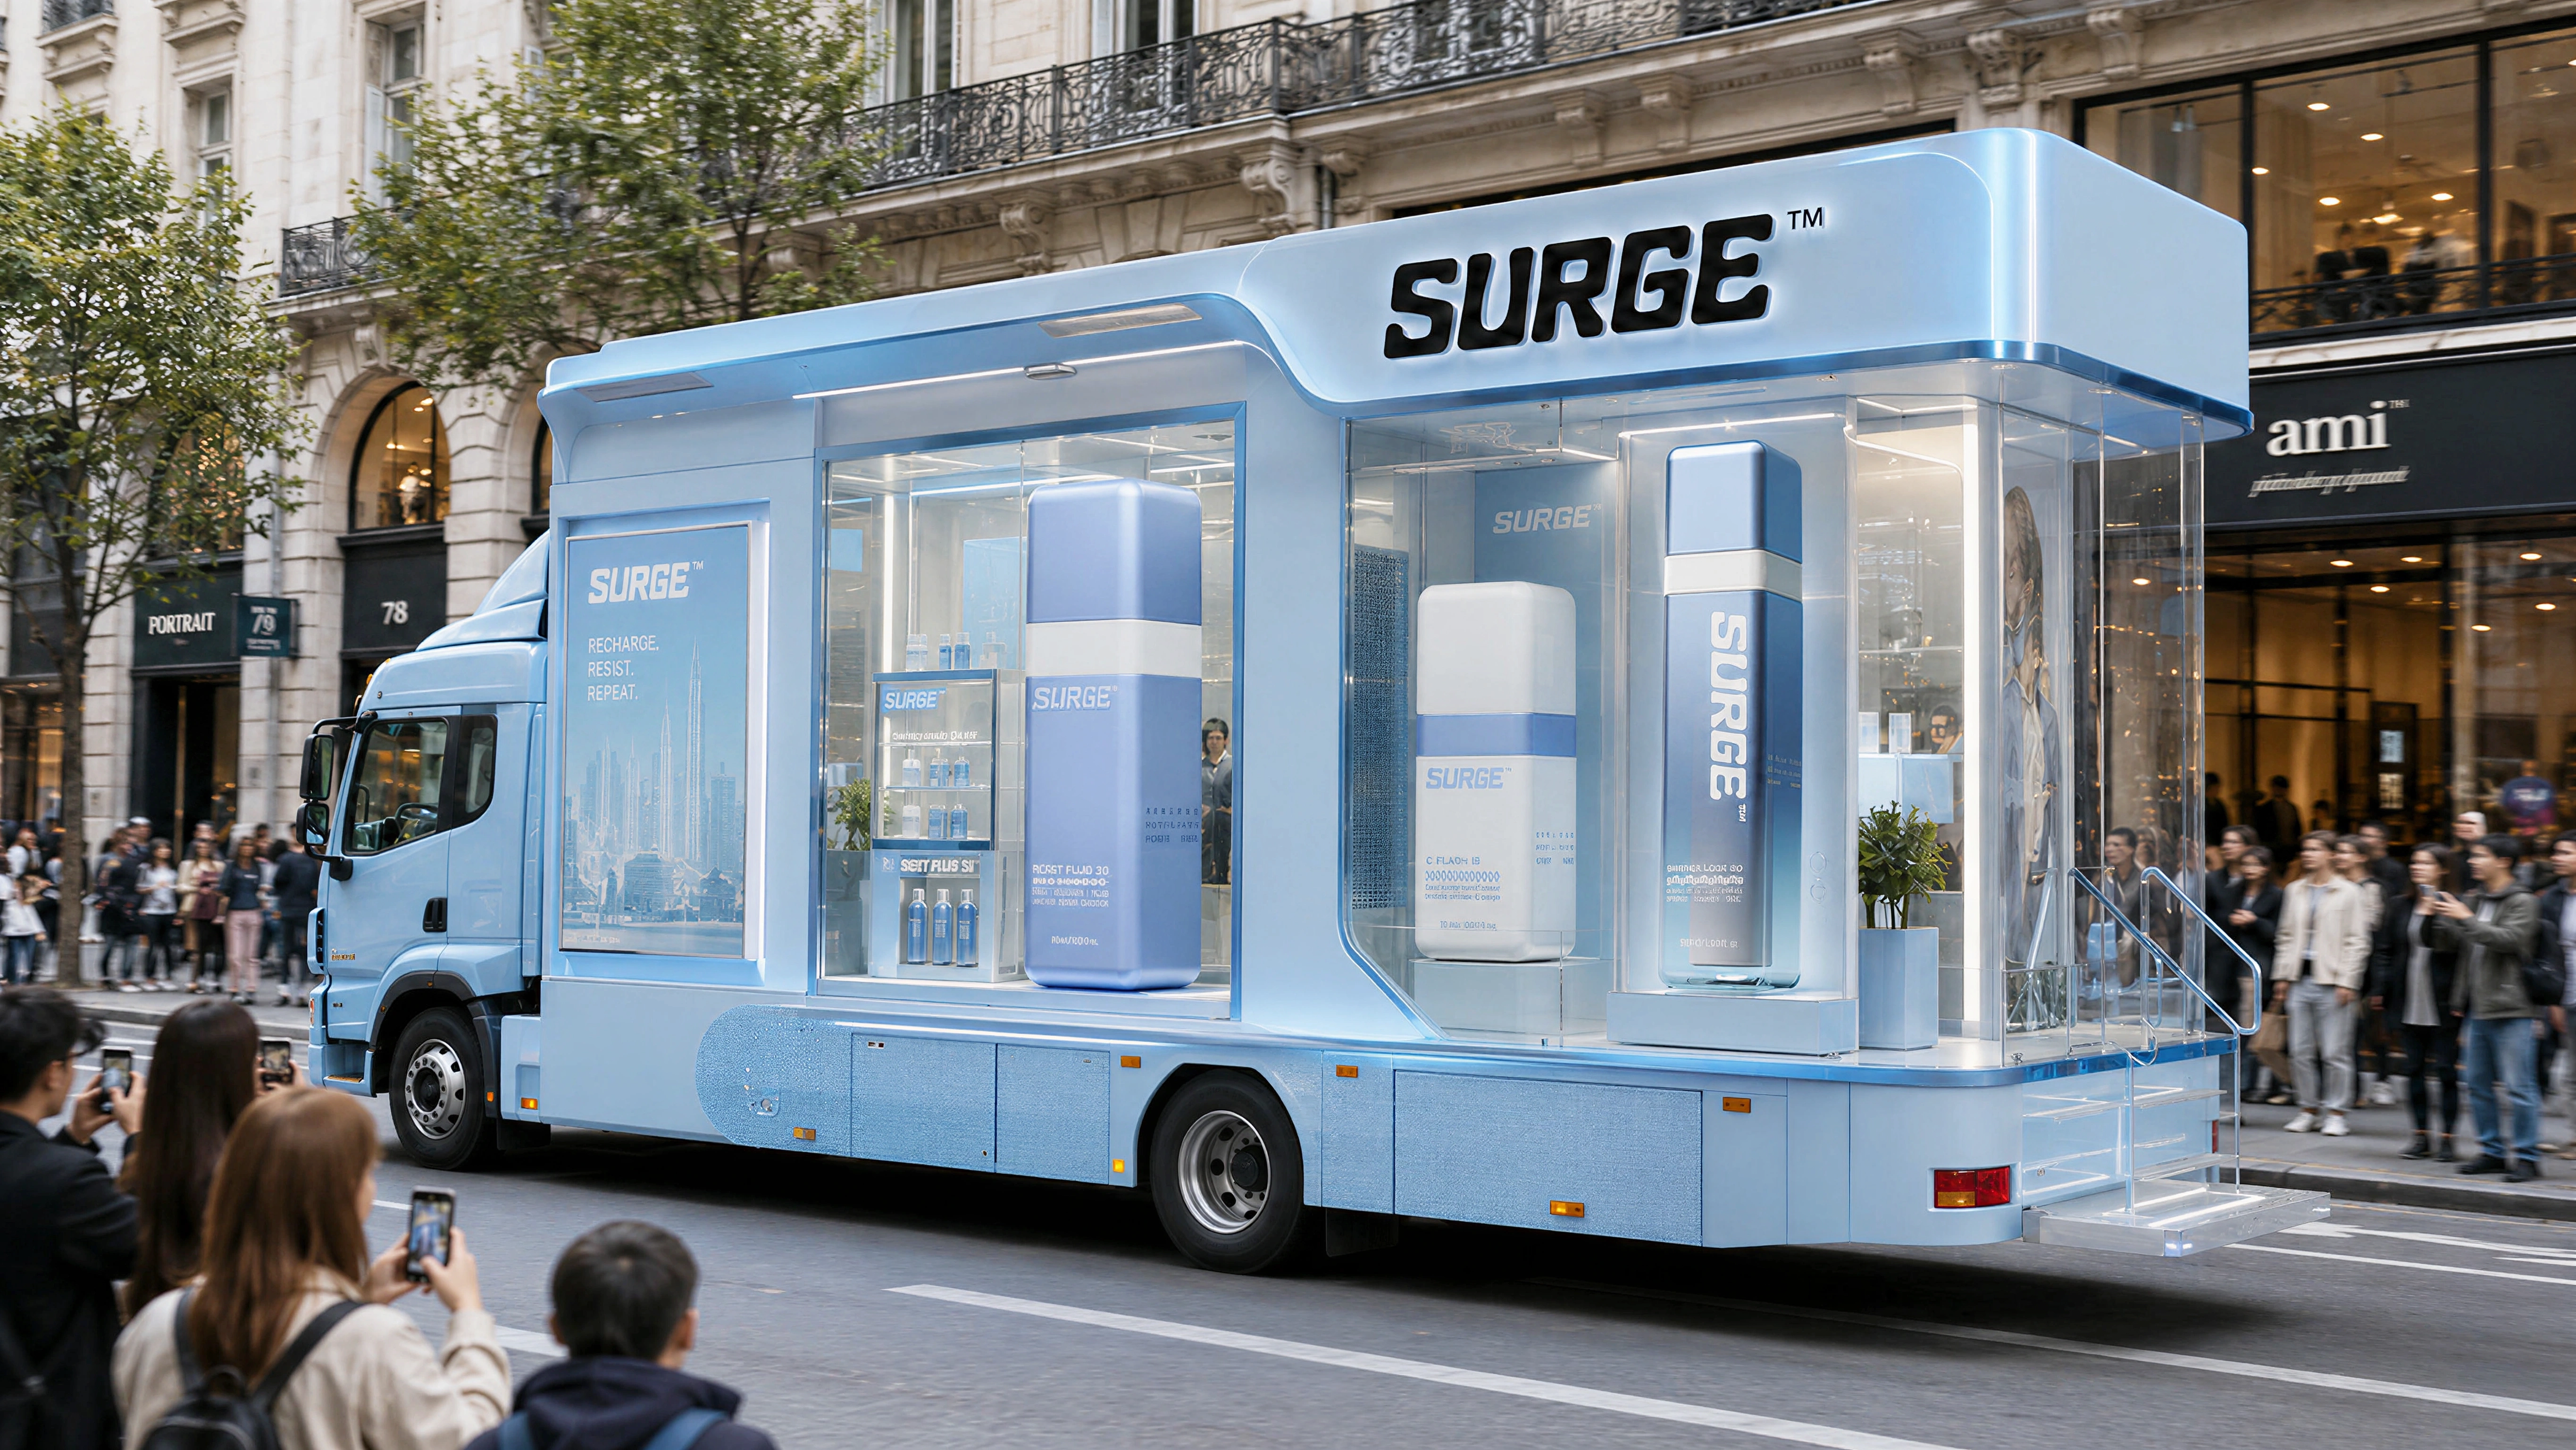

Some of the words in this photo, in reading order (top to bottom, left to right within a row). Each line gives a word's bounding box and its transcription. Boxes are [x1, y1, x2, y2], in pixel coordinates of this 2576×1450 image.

[1383, 213, 1774, 360] SURGE
[1787, 207, 1824, 230] TM
[2266, 401, 2392, 456] ami
[1493, 504, 1591, 534] SURGE
[588, 562, 690, 603] SURGE
[148, 612, 216, 635] PORTRAIT
[380, 600, 409, 625] 78
[588, 660, 634, 678] RESIST.
[587, 684, 638, 701] REPEAT.
[885, 691, 937, 709] SURGE
[1032, 686, 1111, 710] SURGE
[1710, 611, 1747, 800] SURGE
[1426, 767, 1504, 789] SURGE
